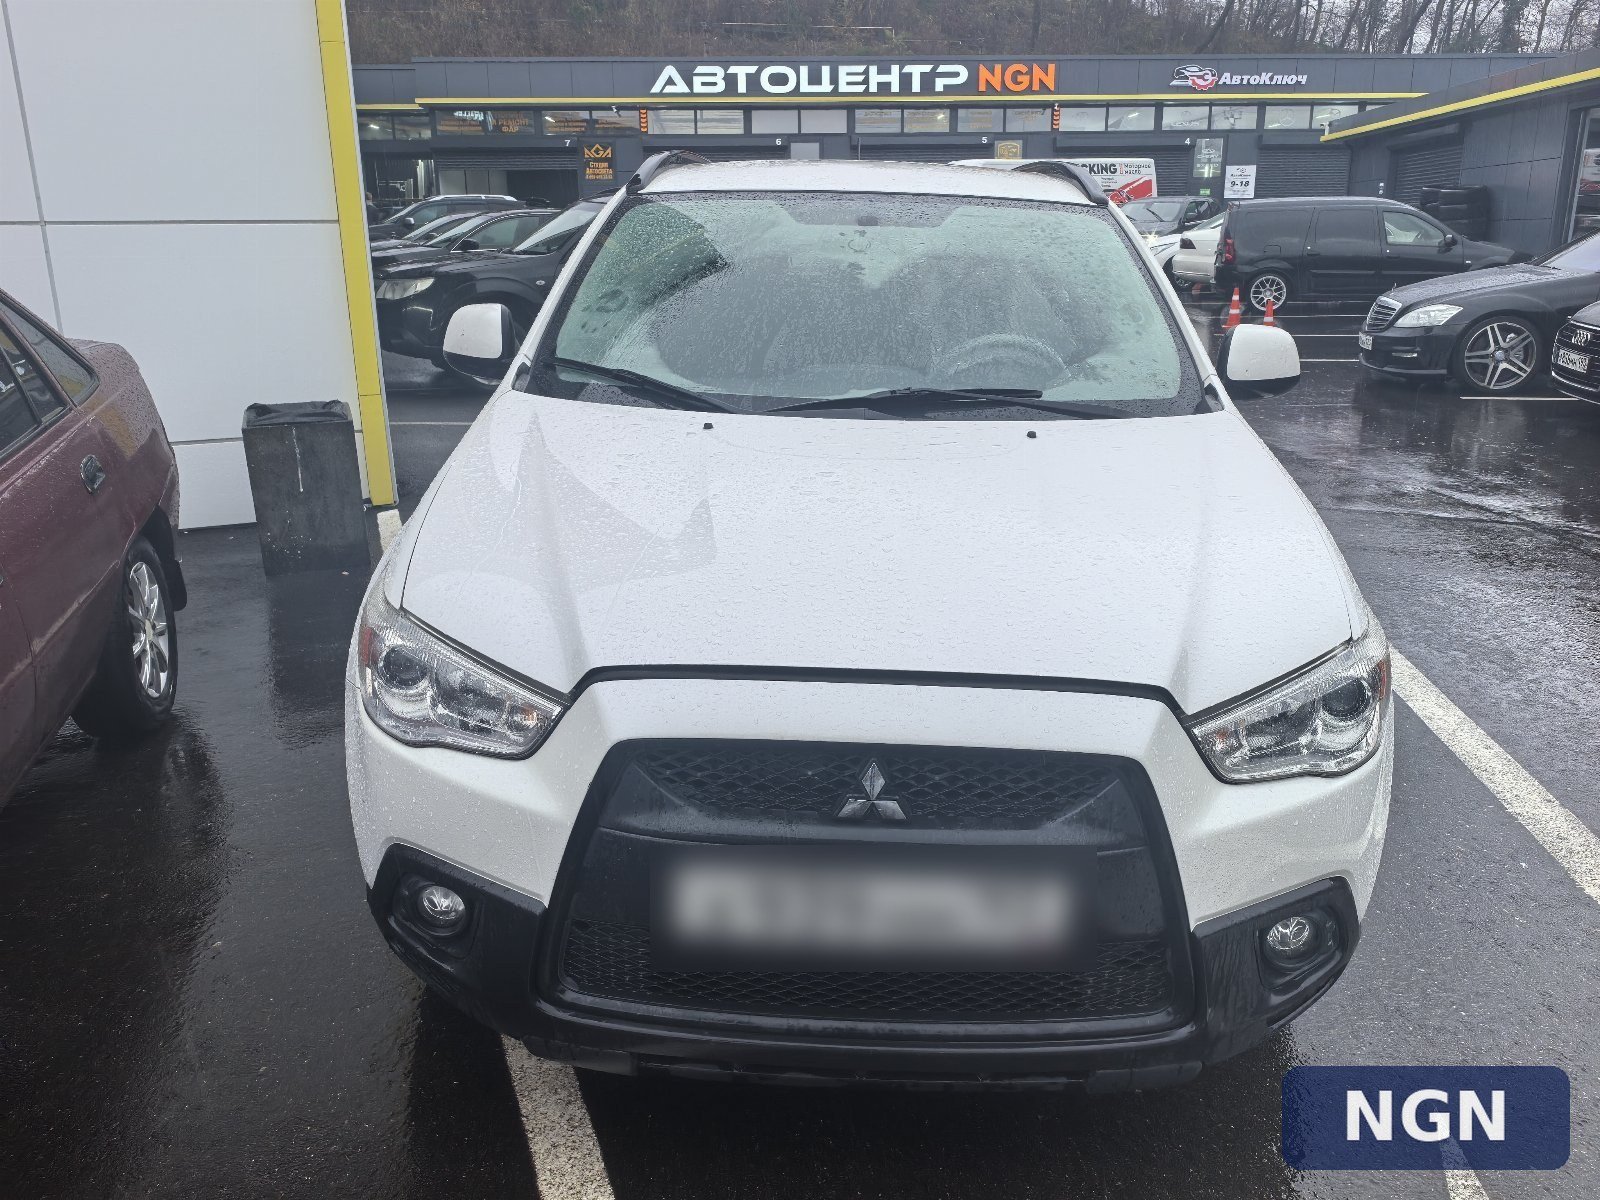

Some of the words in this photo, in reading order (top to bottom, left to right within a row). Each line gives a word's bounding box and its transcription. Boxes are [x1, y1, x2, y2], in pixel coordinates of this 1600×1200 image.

[650, 64, 968, 94] АВТОЦЕНТР
[978, 63, 1056, 92] NGN
[564, 139, 571, 147] 7
[775, 138, 782, 146] 6
[981, 136, 988, 144] 5
[1184, 137, 1191, 146] 4
[1230, 180, 1250, 188] 9-18
